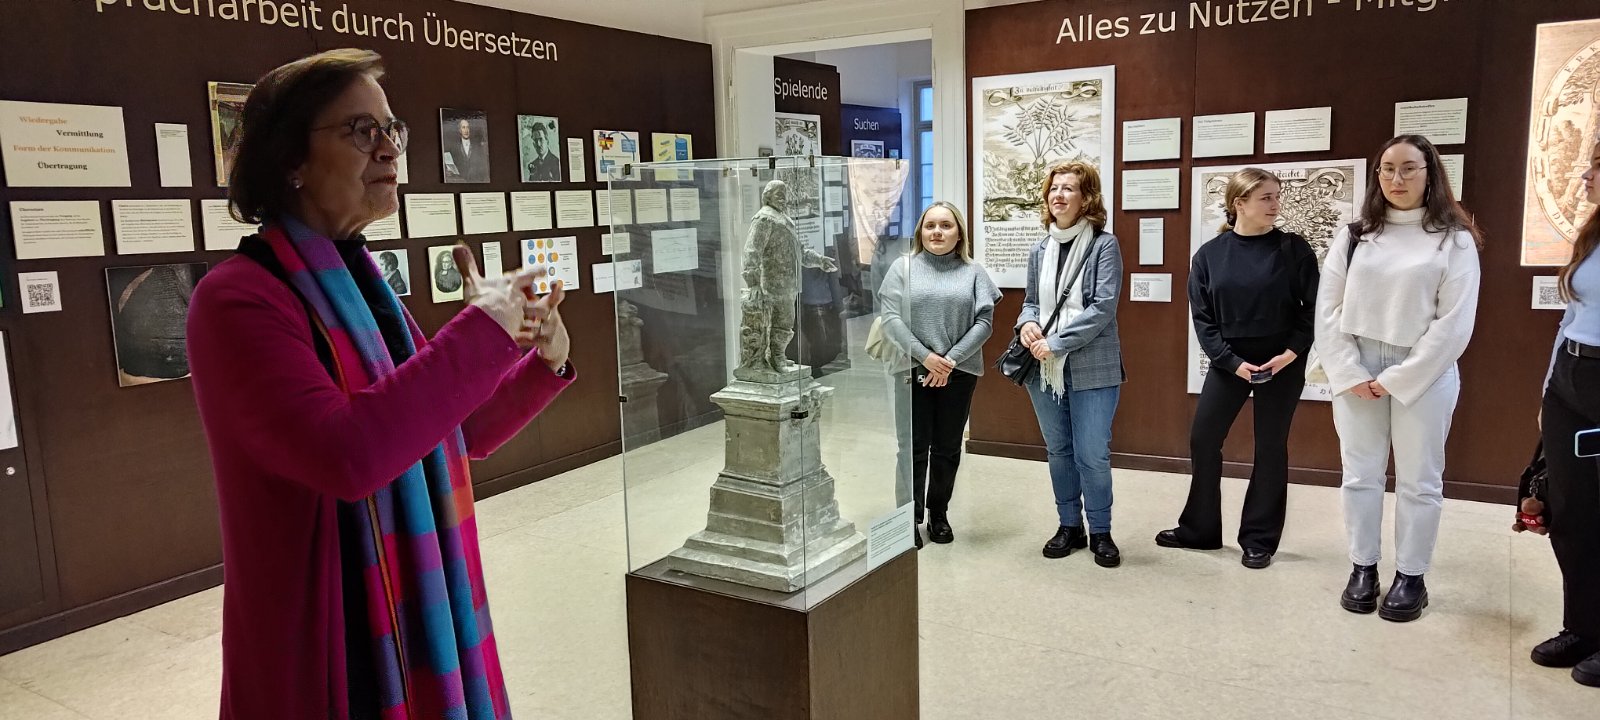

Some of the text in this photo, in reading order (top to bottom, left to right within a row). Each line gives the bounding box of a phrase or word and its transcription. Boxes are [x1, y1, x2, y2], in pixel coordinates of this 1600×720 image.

[1056, 14, 1130, 44] Alles
[1139, 11, 1176, 35] zu
[1189, 0, 1312, 29] Nutzen
[331, 4, 415, 43] durch
[423, 12, 558, 61] Übersetzen
[774, 77, 828, 100] Spielende
[19, 116, 68, 125] Wiedergabe
[854, 118, 880, 131] Suchen
[56, 130, 104, 139] Vermittlung
[37, 161, 88, 170] Übertragung
